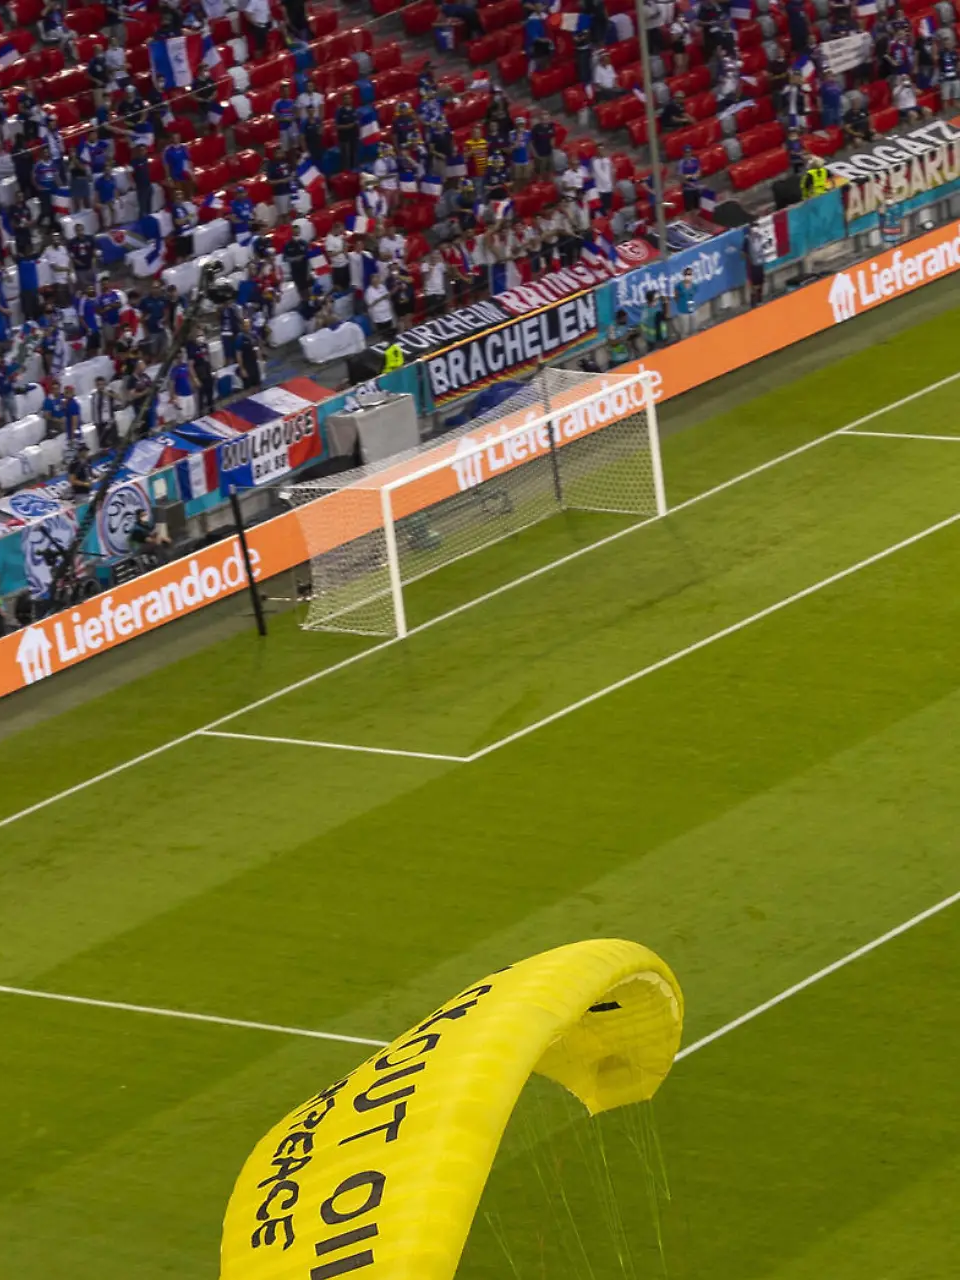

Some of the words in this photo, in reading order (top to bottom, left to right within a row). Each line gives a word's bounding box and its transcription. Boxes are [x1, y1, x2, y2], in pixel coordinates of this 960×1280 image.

[428, 292, 597, 396] BRACHELEN
[221, 409, 315, 471] MULHOUSE
[52, 542, 261, 663] Lieferando.de
[339, 1033, 442, 1146] OUT
